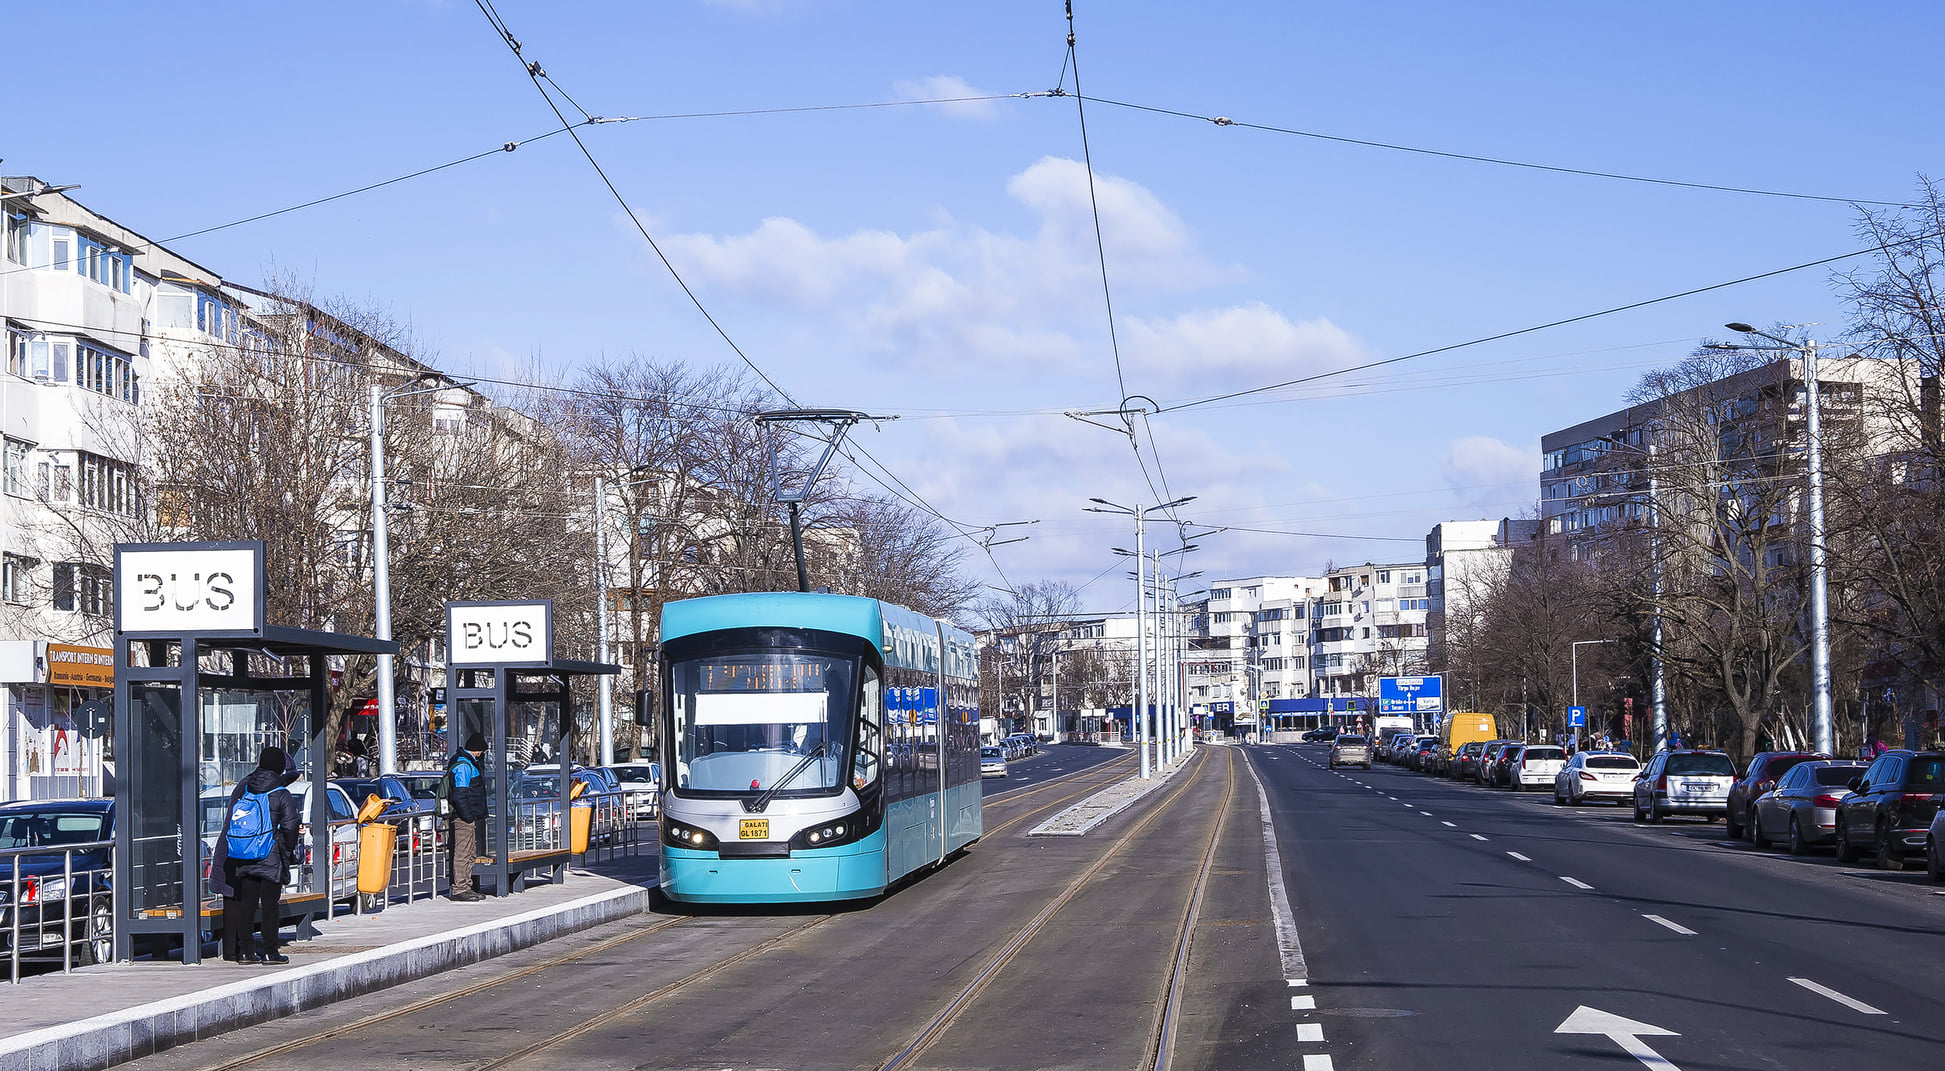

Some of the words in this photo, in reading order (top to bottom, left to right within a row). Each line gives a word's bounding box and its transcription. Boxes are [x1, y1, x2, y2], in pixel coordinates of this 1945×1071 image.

[137, 572, 235, 611] BUS
[463, 621, 532, 649] BUS
[50, 650, 77, 663] TRANSPORT
[1572, 709, 1581, 721] P
